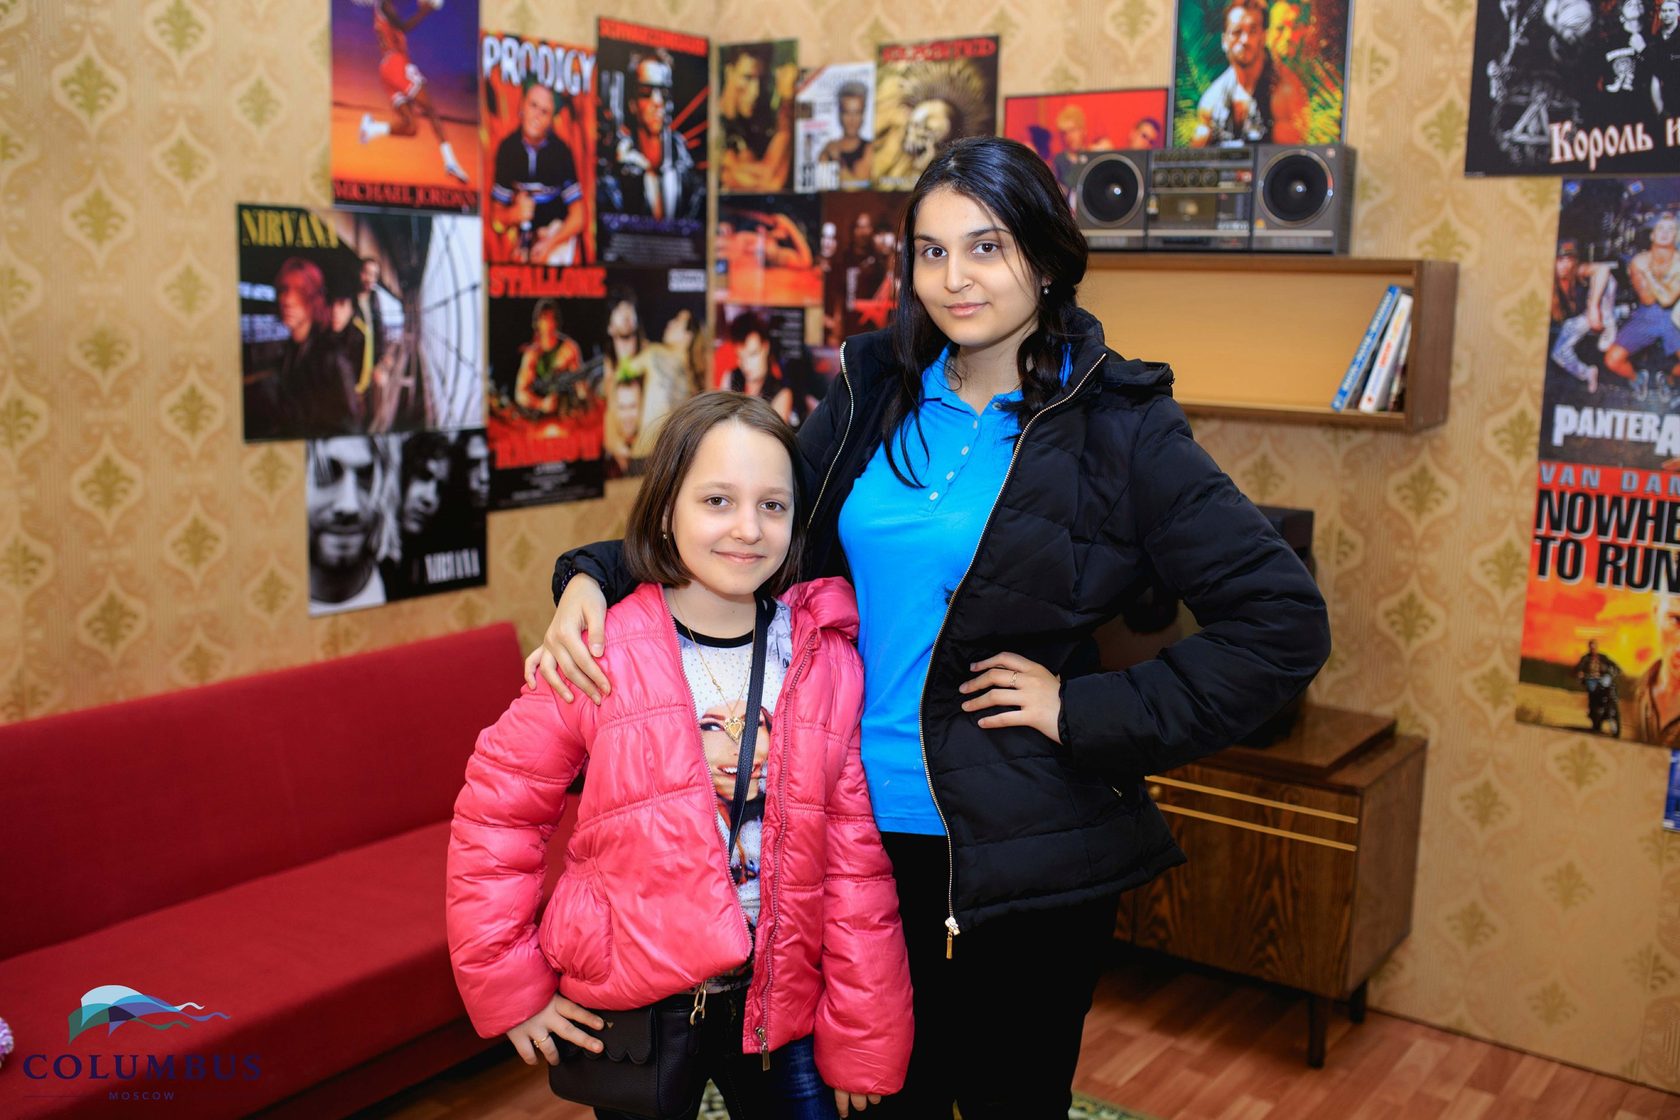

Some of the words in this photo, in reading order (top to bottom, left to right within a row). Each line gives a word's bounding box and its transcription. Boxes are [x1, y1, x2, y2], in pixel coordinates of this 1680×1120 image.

[482, 35, 597, 96] PRODIGY
[1549, 119, 1654, 171] Король
[241, 209, 339, 249] NIRVANA
[489, 266, 607, 298] STALLONE
[1552, 403, 1680, 456] PANTERA
[1540, 462, 1600, 490] VAN
[1535, 489, 1680, 547] NOWHE
[1534, 535, 1586, 585] TO
[1595, 543, 1680, 595] RUN
